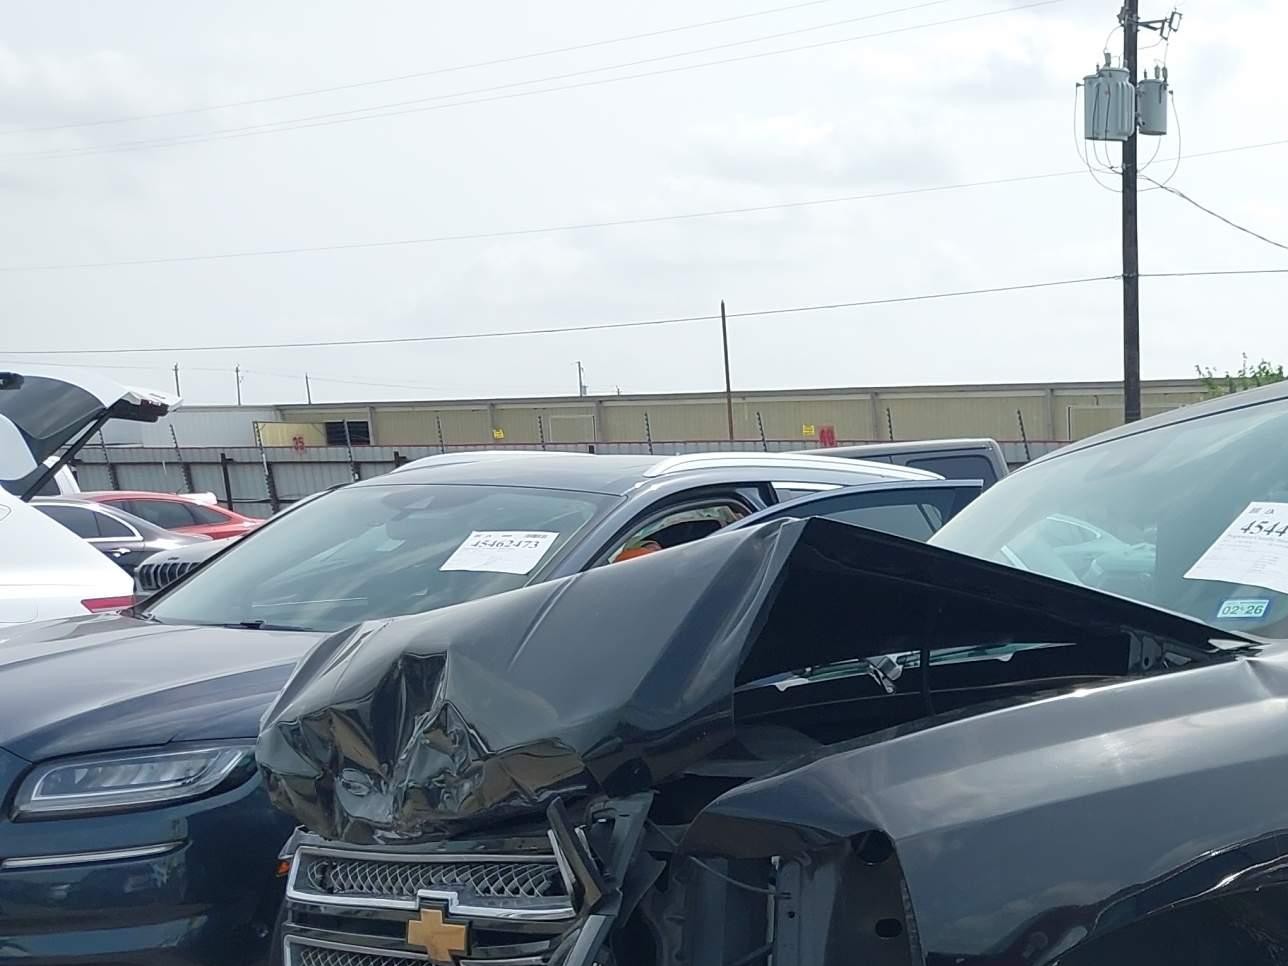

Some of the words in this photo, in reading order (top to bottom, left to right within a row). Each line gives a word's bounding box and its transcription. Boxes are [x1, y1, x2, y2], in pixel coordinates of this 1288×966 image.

[471, 539, 540, 549] 45462473
[1222, 605, 1240, 615] 02
[1245, 605, 1264, 614] 26
